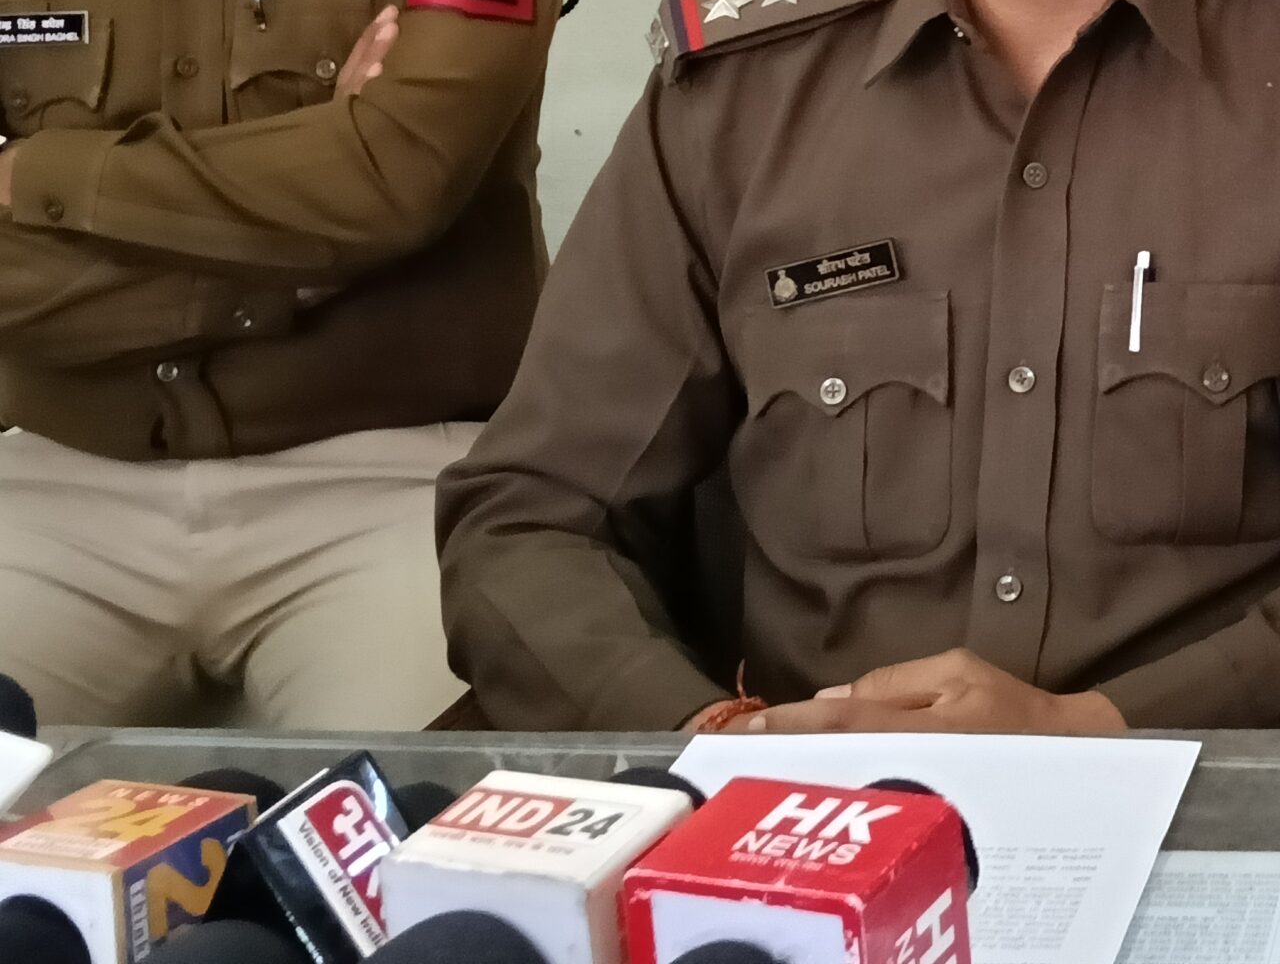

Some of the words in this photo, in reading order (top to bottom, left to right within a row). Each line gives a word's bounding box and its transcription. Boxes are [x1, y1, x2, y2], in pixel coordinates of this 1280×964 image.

[804, 273, 857, 294] SOURABH
[858, 265, 891, 281] PATEL
[439, 791, 555, 830] IND
[545, 807, 624, 840] 24
[754, 792, 903, 844] HK
[731, 830, 862, 865] NEWS
[298, 823, 330, 867] Vision
[339, 884, 362, 916] New
[360, 913, 388, 947] Indi
